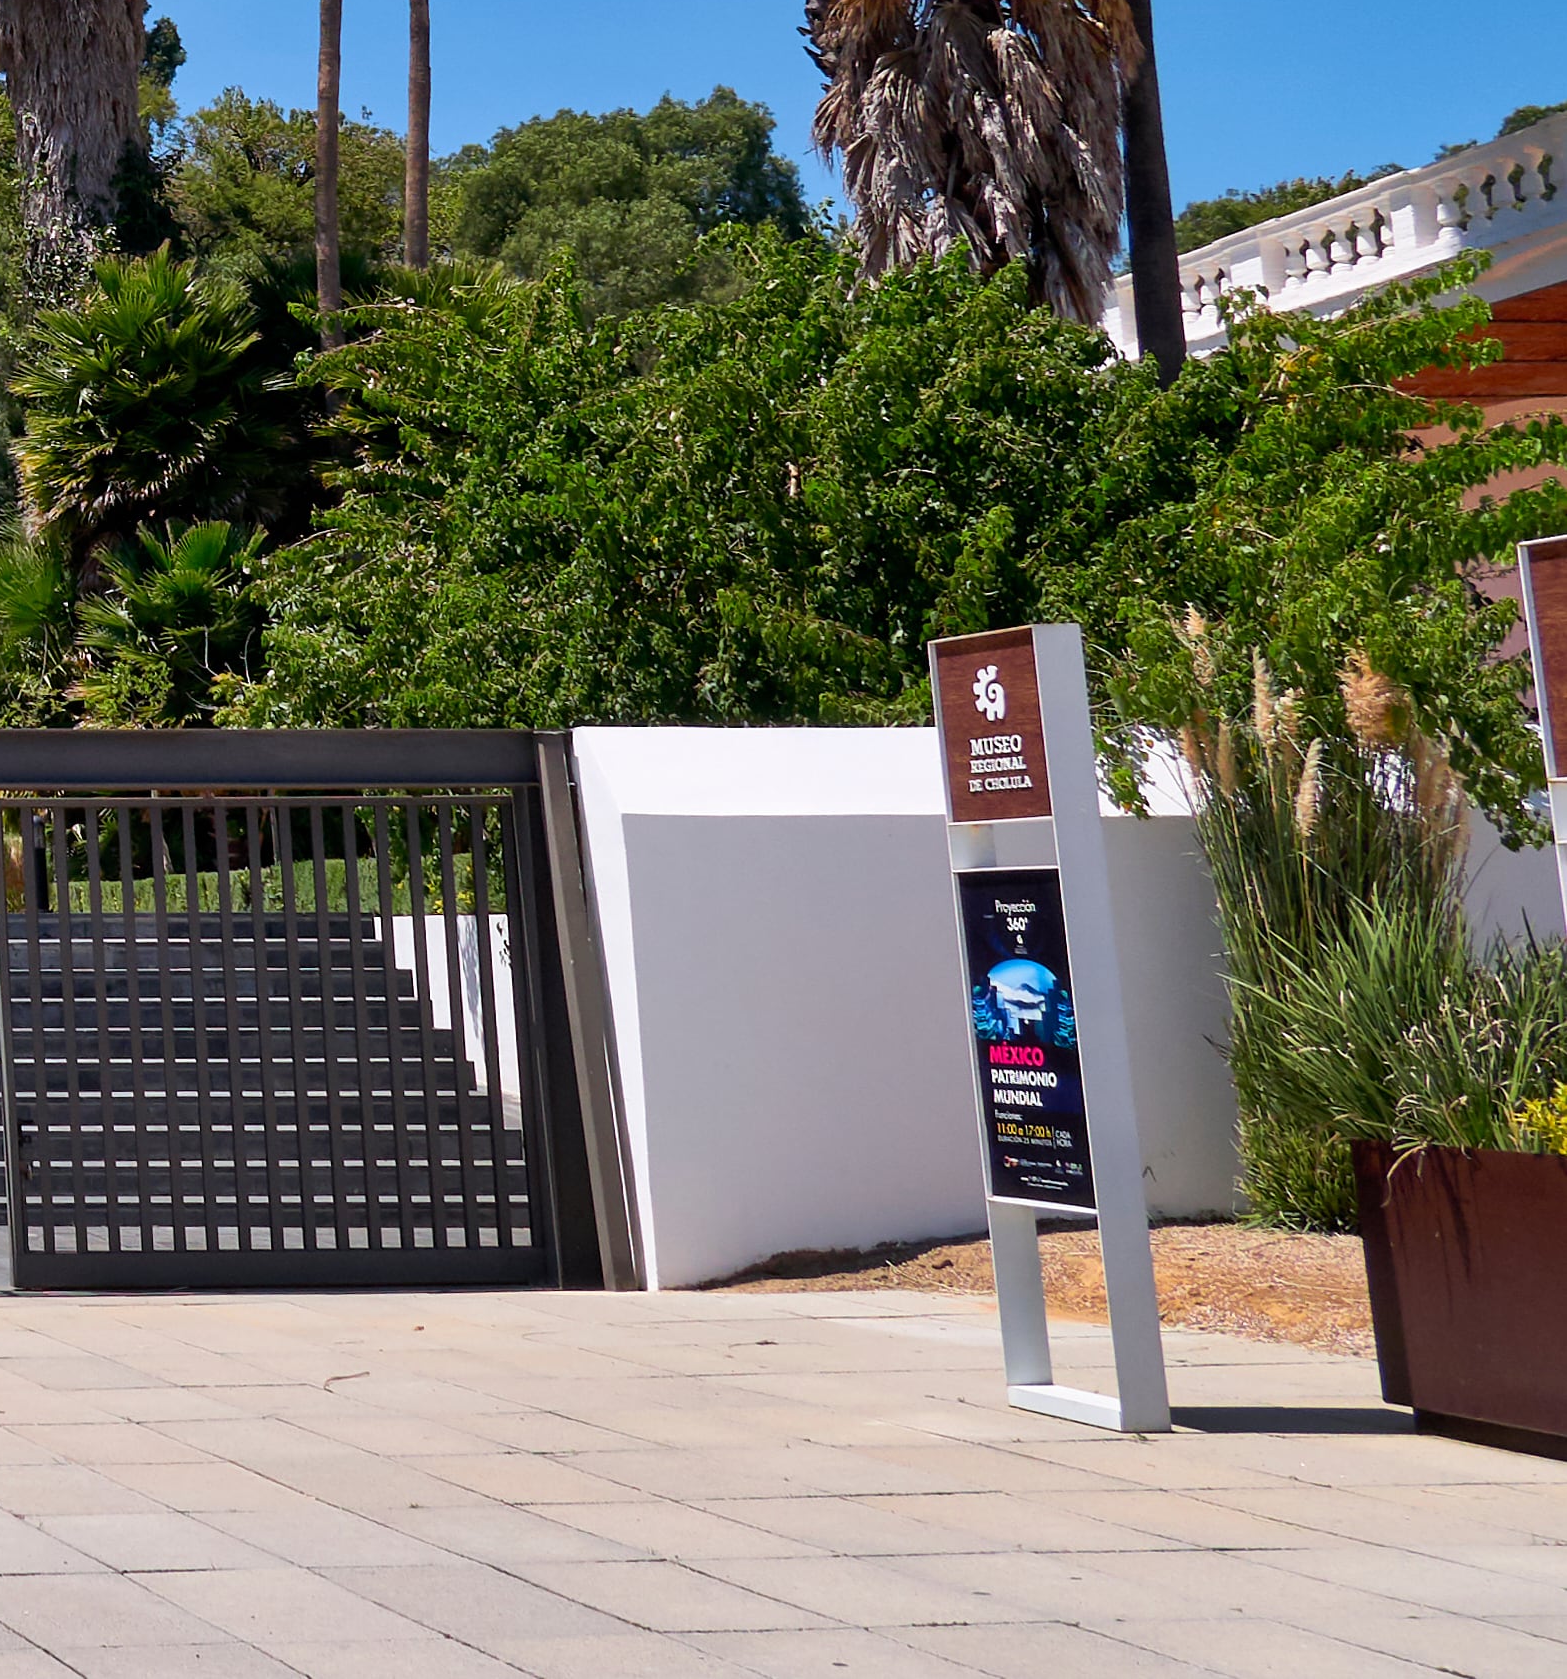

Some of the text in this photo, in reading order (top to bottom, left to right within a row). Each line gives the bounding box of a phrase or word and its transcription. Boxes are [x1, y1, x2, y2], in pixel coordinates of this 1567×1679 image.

[970, 734, 1022, 756] MUSEO
[970, 755, 1027, 773] REGIONAL
[968, 775, 1032, 792] DE CHOLULA
[989, 1041, 1045, 1066] MÉXICO
[990, 1068, 1058, 1088] PATRIMONIO
[993, 1089, 1044, 1107] MUNDIAL
[997, 1122, 1018, 1135] 11:00
[1024, 1124, 1045, 1138] 17:00
